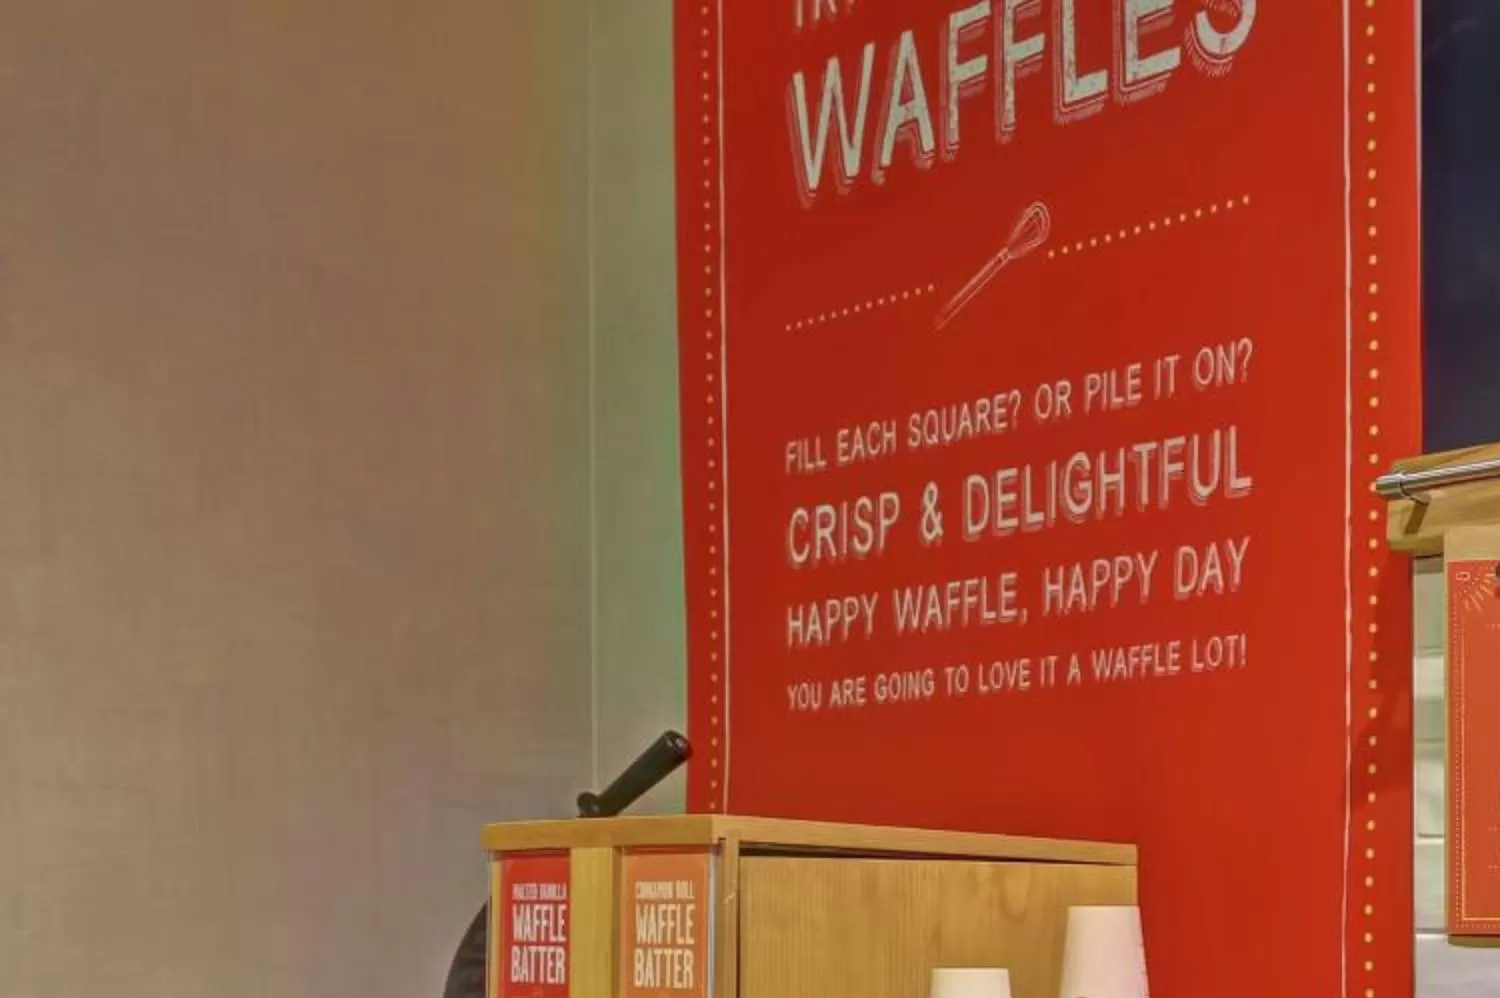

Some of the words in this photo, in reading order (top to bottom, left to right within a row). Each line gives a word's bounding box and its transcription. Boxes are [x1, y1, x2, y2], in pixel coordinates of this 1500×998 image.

[785, 432, 827, 475] FILL
[836, 418, 897, 464] EACH
[907, 388, 1021, 448] SQUARE?
[1034, 379, 1072, 421] OR
[1083, 362, 1143, 415] PILE
[1154, 354, 1182, 400] IT
[1193, 336, 1254, 391] ON?
[787, 491, 901, 569] CRISP
[919, 480, 944, 545] &
[961, 424, 1254, 542] DELIGHTFUL
[787, 591, 879, 648] HAPPY
[892, 571, 1029, 637] WAFFLE,
[1042, 549, 1159, 617] HAPPY
[1173, 535, 1250, 600] DAY
[787, 682, 823, 712] YOU
[828, 676, 868, 709] ARE
[874, 668, 936, 704] GOING
[943, 663, 970, 696] TO
[978, 657, 1031, 696] LOVE
[1039, 655, 1060, 688] IT
[1066, 653, 1082, 686] A
[1091, 640, 1182, 681] WAFFLE
[1191, 633, 1248, 672] LOT!
[512, 903, 568, 943] WAFFLE
[635, 903, 696, 945] WAFFLE
[511, 945, 566, 985] BATTER
[634, 948, 694, 990] BATTER
